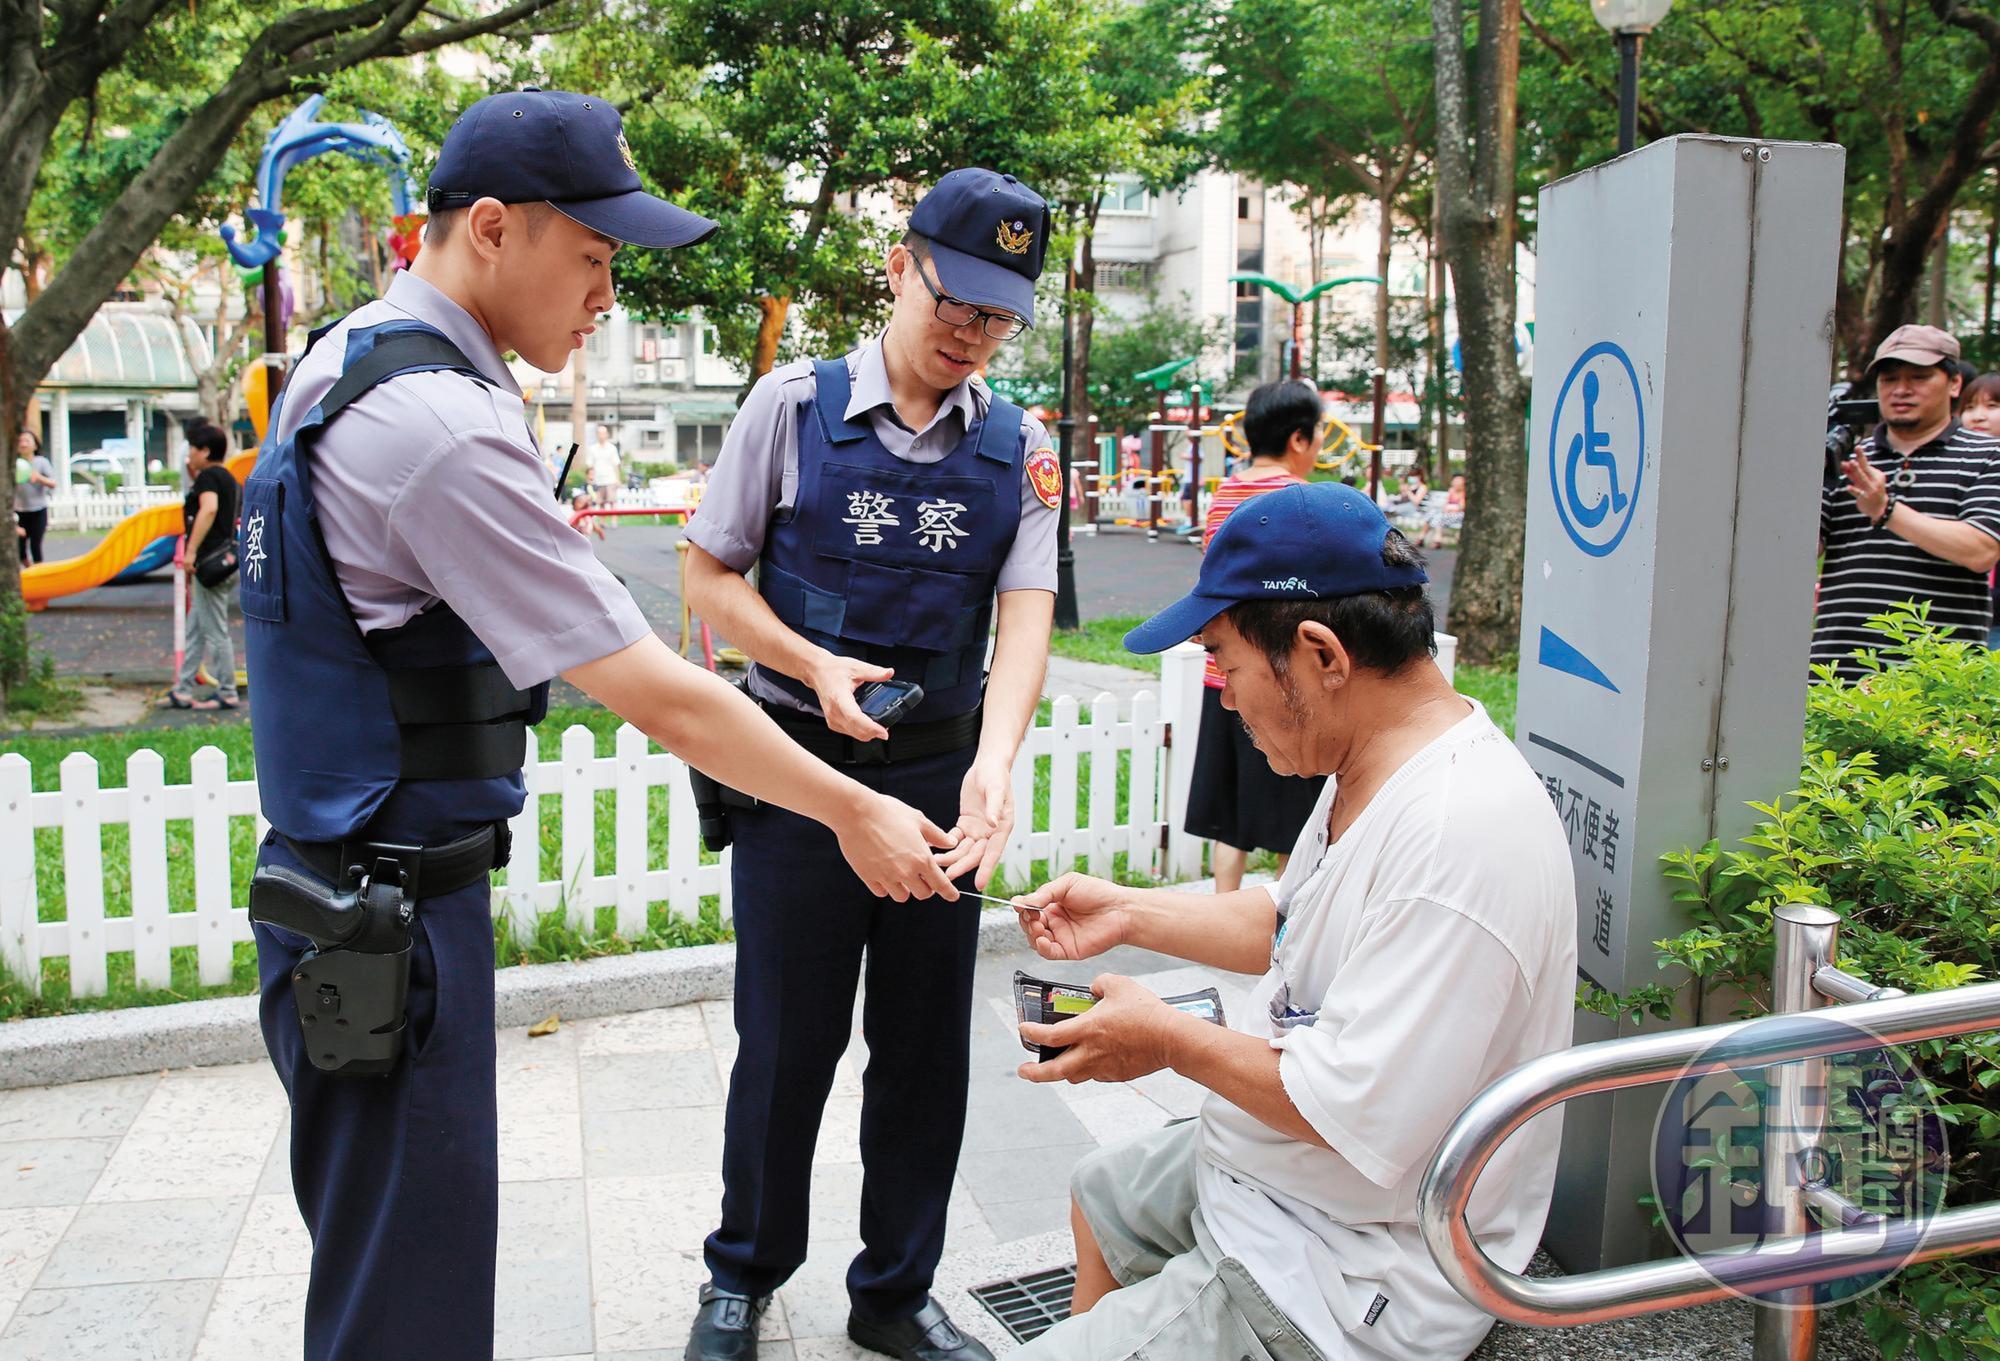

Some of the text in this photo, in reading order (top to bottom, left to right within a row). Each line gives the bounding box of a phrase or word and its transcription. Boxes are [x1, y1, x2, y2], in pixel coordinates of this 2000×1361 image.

[245, 509, 267, 582] 察
[841, 490, 970, 552] 警察
[1592, 886, 1614, 957] 道
